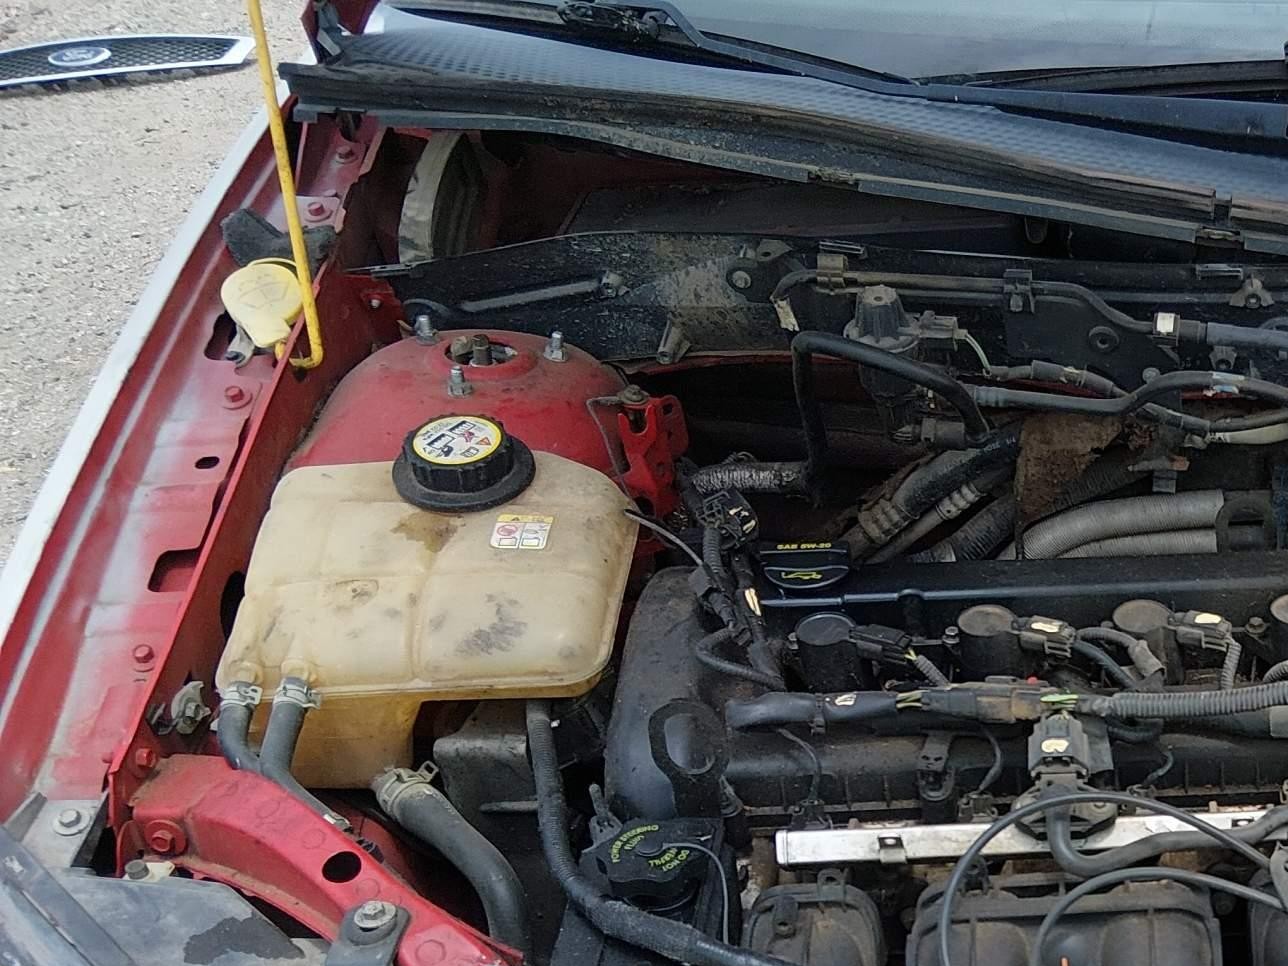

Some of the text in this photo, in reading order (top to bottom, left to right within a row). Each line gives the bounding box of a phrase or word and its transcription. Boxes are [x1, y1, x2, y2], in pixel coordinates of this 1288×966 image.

[611, 824, 660, 863] POWER STEERING
[624, 835, 645, 850] FLUID
